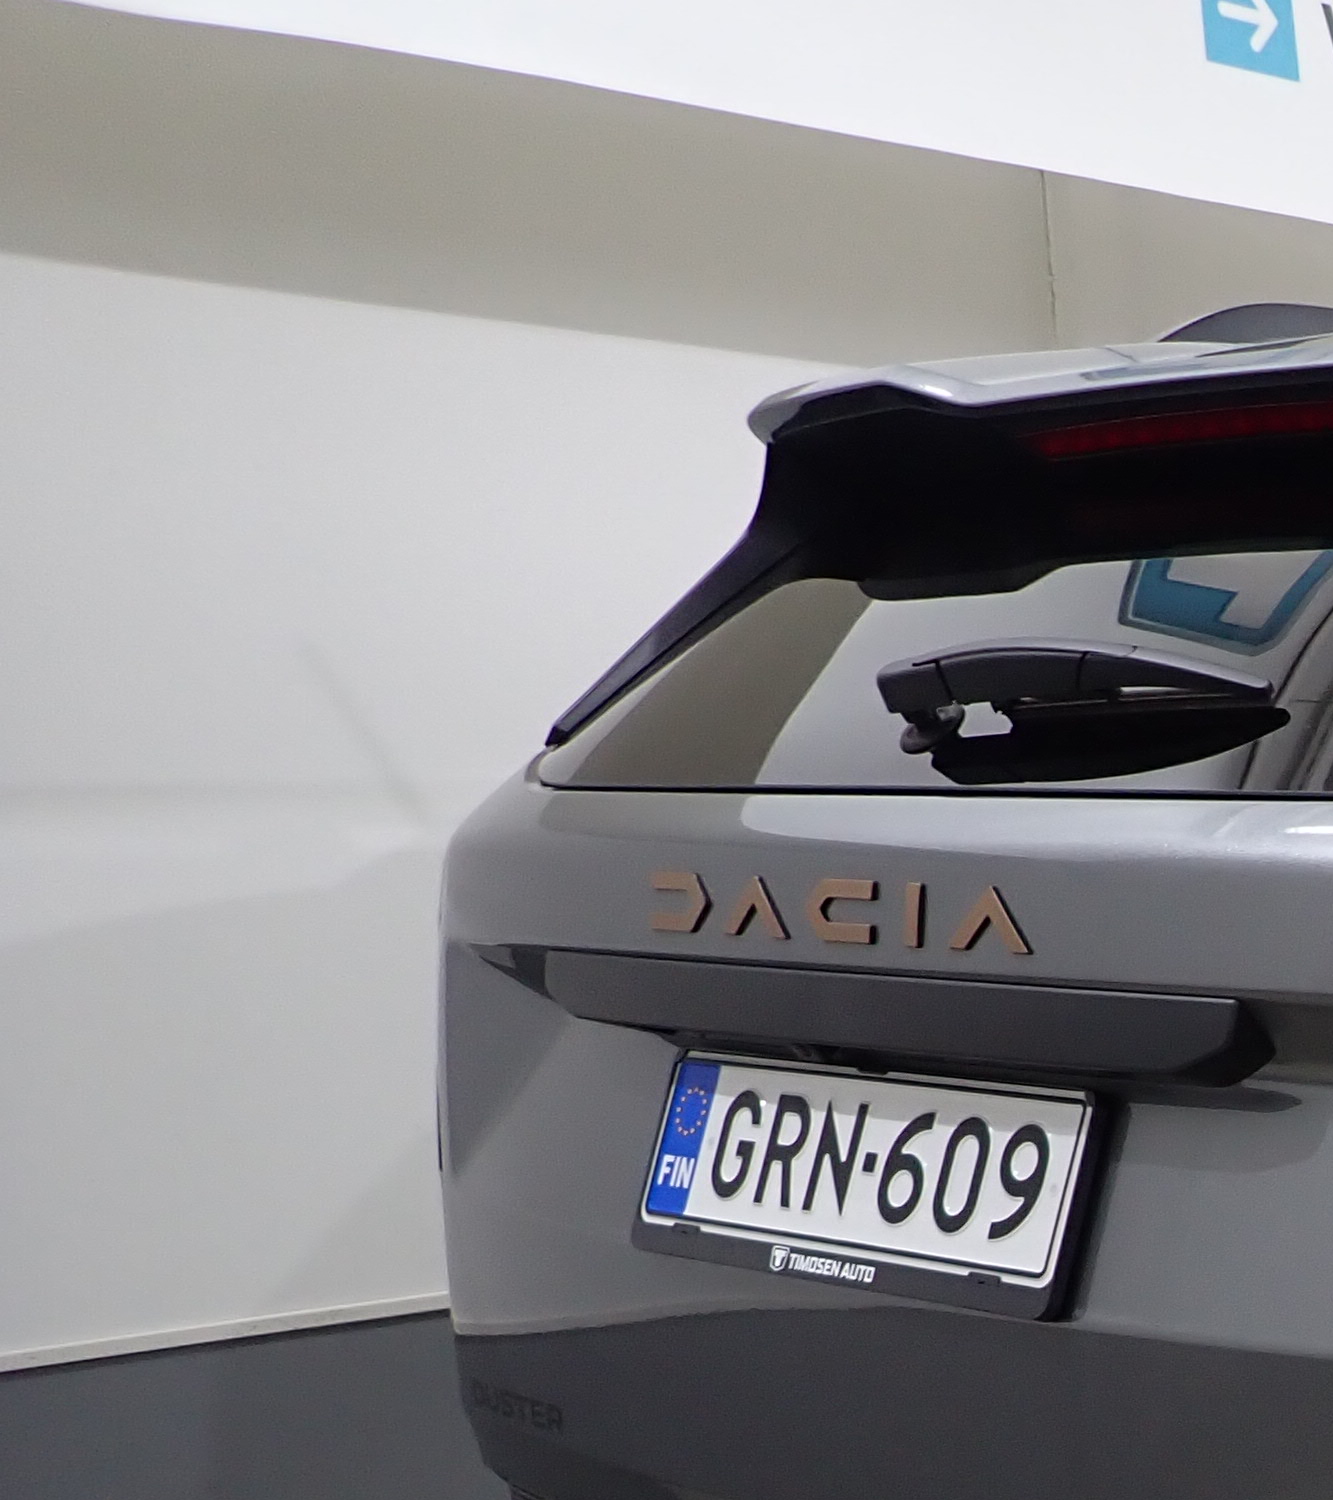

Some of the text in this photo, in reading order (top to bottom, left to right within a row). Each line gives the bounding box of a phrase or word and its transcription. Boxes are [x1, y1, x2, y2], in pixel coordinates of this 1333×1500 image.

[649, 872, 1032, 955] DACIA
[657, 1154, 696, 1190] FIN
[710, 1090, 1051, 1242] GRN-609
[788, 1253, 876, 1283] TIMOSEN AUTO
